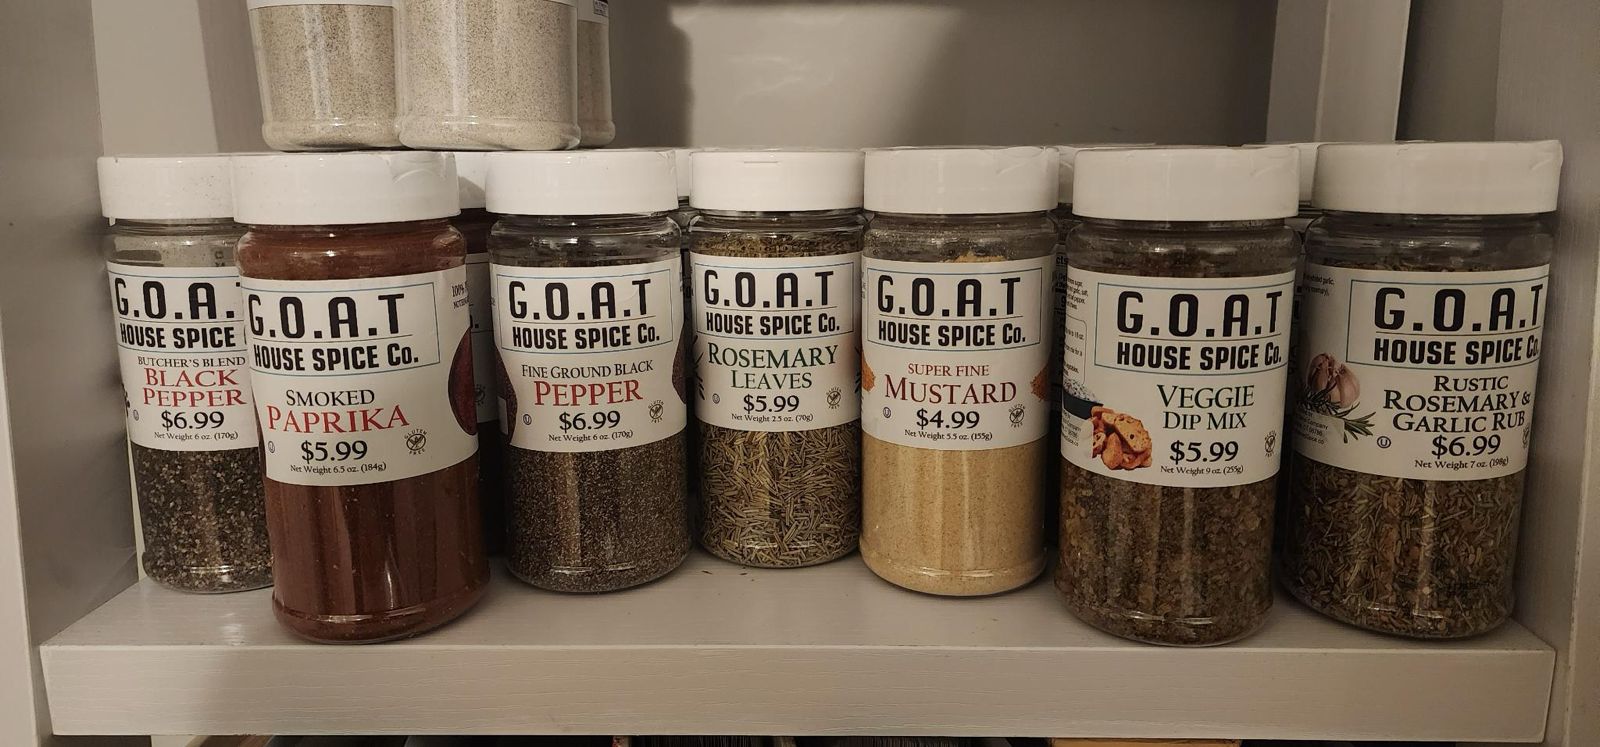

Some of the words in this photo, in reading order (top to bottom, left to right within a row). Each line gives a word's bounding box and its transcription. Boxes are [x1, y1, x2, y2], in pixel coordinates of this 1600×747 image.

[114, 277, 241, 319] G.O.A.
[508, 278, 652, 321] G.O.A.T
[704, 269, 834, 308] G.O.A.T
[877, 274, 1021, 317] G.O.A.T
[248, 293, 405, 339] G.O.A.T
[1116, 290, 1283, 337] G.O.A.T
[1374, 283, 1544, 332] G.O.A.T
[706, 312, 753, 335] HOUSE
[760, 314, 812, 335] SPICE
[818, 313, 840, 332] Co.
[878, 319, 931, 346] HOUSE
[937, 324, 996, 346] SPICE
[1002, 323, 1026, 344] Co.
[119, 322, 167, 348] HOUSE
[172, 326, 236, 349] SPICE
[512, 326, 567, 350] HOUSE
[575, 325, 631, 349] SPICE
[637, 323, 660, 344] Co.
[137, 356, 200, 368] BUTCHER'S
[203, 356, 246, 367] BLEND
[253, 343, 305, 371] HOUSE
[312, 343, 379, 371] SPICE
[387, 342, 419, 366] Co.
[707, 342, 839, 369] ROSEMARY
[1116, 341, 1191, 370] HOUSE
[1200, 344, 1259, 370] SPICE
[1264, 342, 1282, 365] Co.
[1373, 337, 1457, 365] HOUSE
[1465, 337, 1523, 365] SPICE
[143, 367, 240, 388] BLACK
[522, 364, 548, 379] FINE
[550, 365, 612, 379] GROUND
[614, 360, 654, 376] BLACK
[730, 369, 813, 390] LEAVES
[907, 363, 951, 377] SUPER
[956, 364, 990, 377] FINE
[533, 379, 644, 407] PEPPER
[884, 374, 1017, 405] MUSTARD
[1433, 375, 1509, 392] RUSTIC
[143, 387, 248, 408] PEPPER
[285, 389, 375, 407] SMOKED
[743, 394, 800, 414] $5.99
[1156, 384, 1255, 409] VEGGIE
[1382, 389, 1520, 413] ROSEMARY
[1521, 391, 1531, 406] &
[161, 409, 225, 432] $6.99
[266, 404, 410, 434] PAPRIKA
[559, 410, 621, 433] $6.99
[731, 413, 743, 421] Net
[744, 414, 770, 423] Weight
[795, 414, 814, 422] (70g)
[916, 408, 980, 430] $4.99
[1162, 410, 1201, 430] DIP
[1206, 412, 1247, 430] MIX
[1392, 413, 1487, 433] GARLIC
[1492, 410, 1525, 431] RUB
[154, 431, 166, 439] Net
[166, 432, 193, 441] Weight
[213, 431, 239, 441] (170g)
[548, 434, 561, 442] Net
[562, 433, 591, 443] Weight
[611, 429, 634, 441] (170g)
[904, 429, 917, 438] Net
[917, 430, 945, 441] Weight
[946, 432, 958, 440] 5.5
[970, 431, 993, 441] (155g)
[1431, 434, 1502, 459] $6.99
[301, 440, 368, 464] $5.99
[1169, 440, 1239, 465] $5.99
[290, 464, 302, 473] Net
[303, 463, 332, 475] Weight
[333, 465, 345, 473] 6.5
[347, 465, 359, 473] oz.
[360, 461, 387, 473] (184g)
[1160, 465, 1174, 474] Net
[1176, 466, 1205, 476] Weight
[1414, 459, 1433, 468] Net
[1434, 460, 1468, 471] Weight
[1470, 460, 1476, 468] 7
